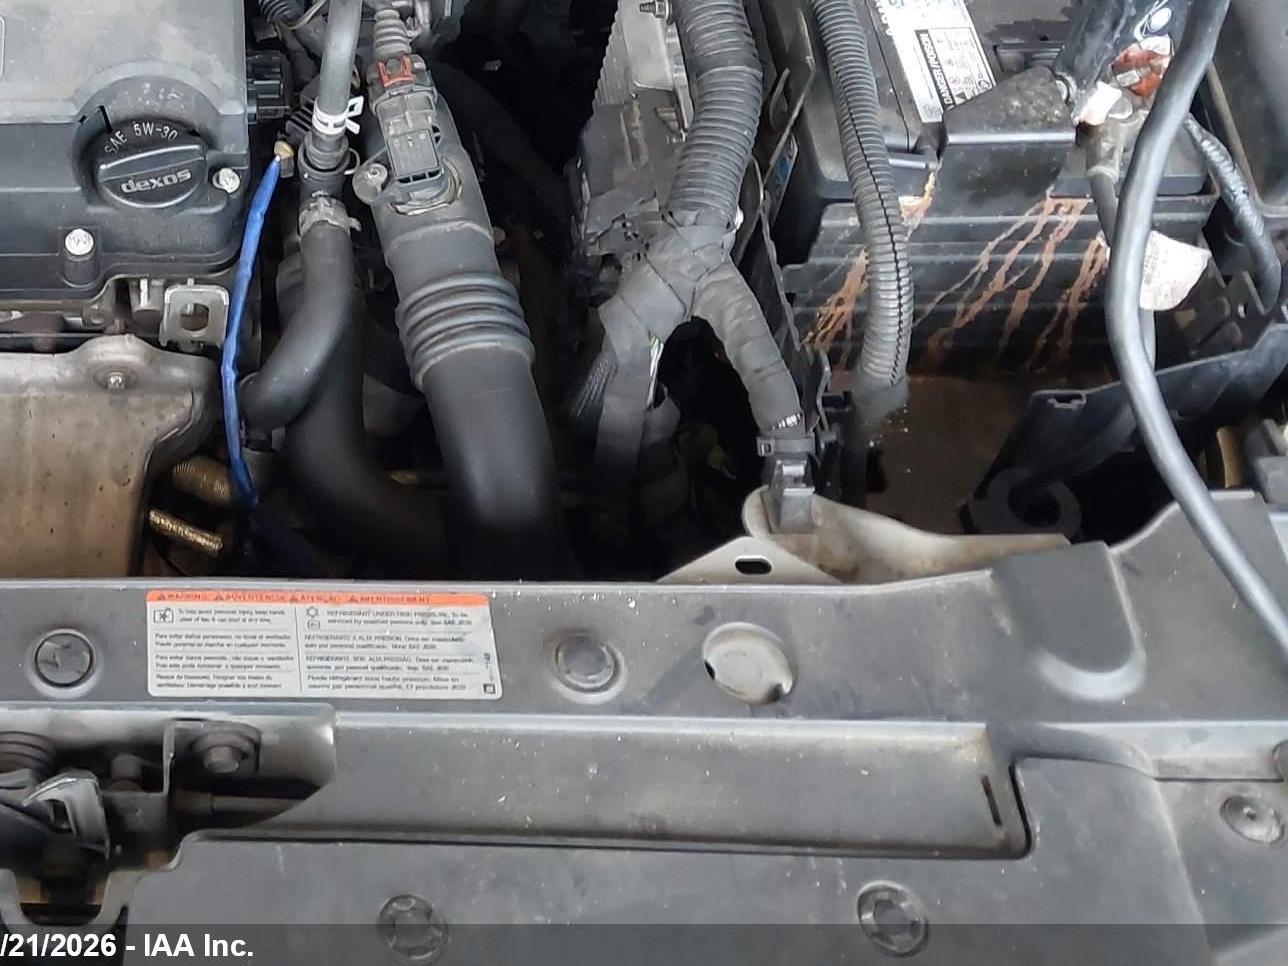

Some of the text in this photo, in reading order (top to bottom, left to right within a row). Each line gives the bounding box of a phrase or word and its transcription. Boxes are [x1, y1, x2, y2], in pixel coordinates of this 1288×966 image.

[104, 121, 178, 154] SAE 5W-30
[121, 169, 191, 193] dexos
